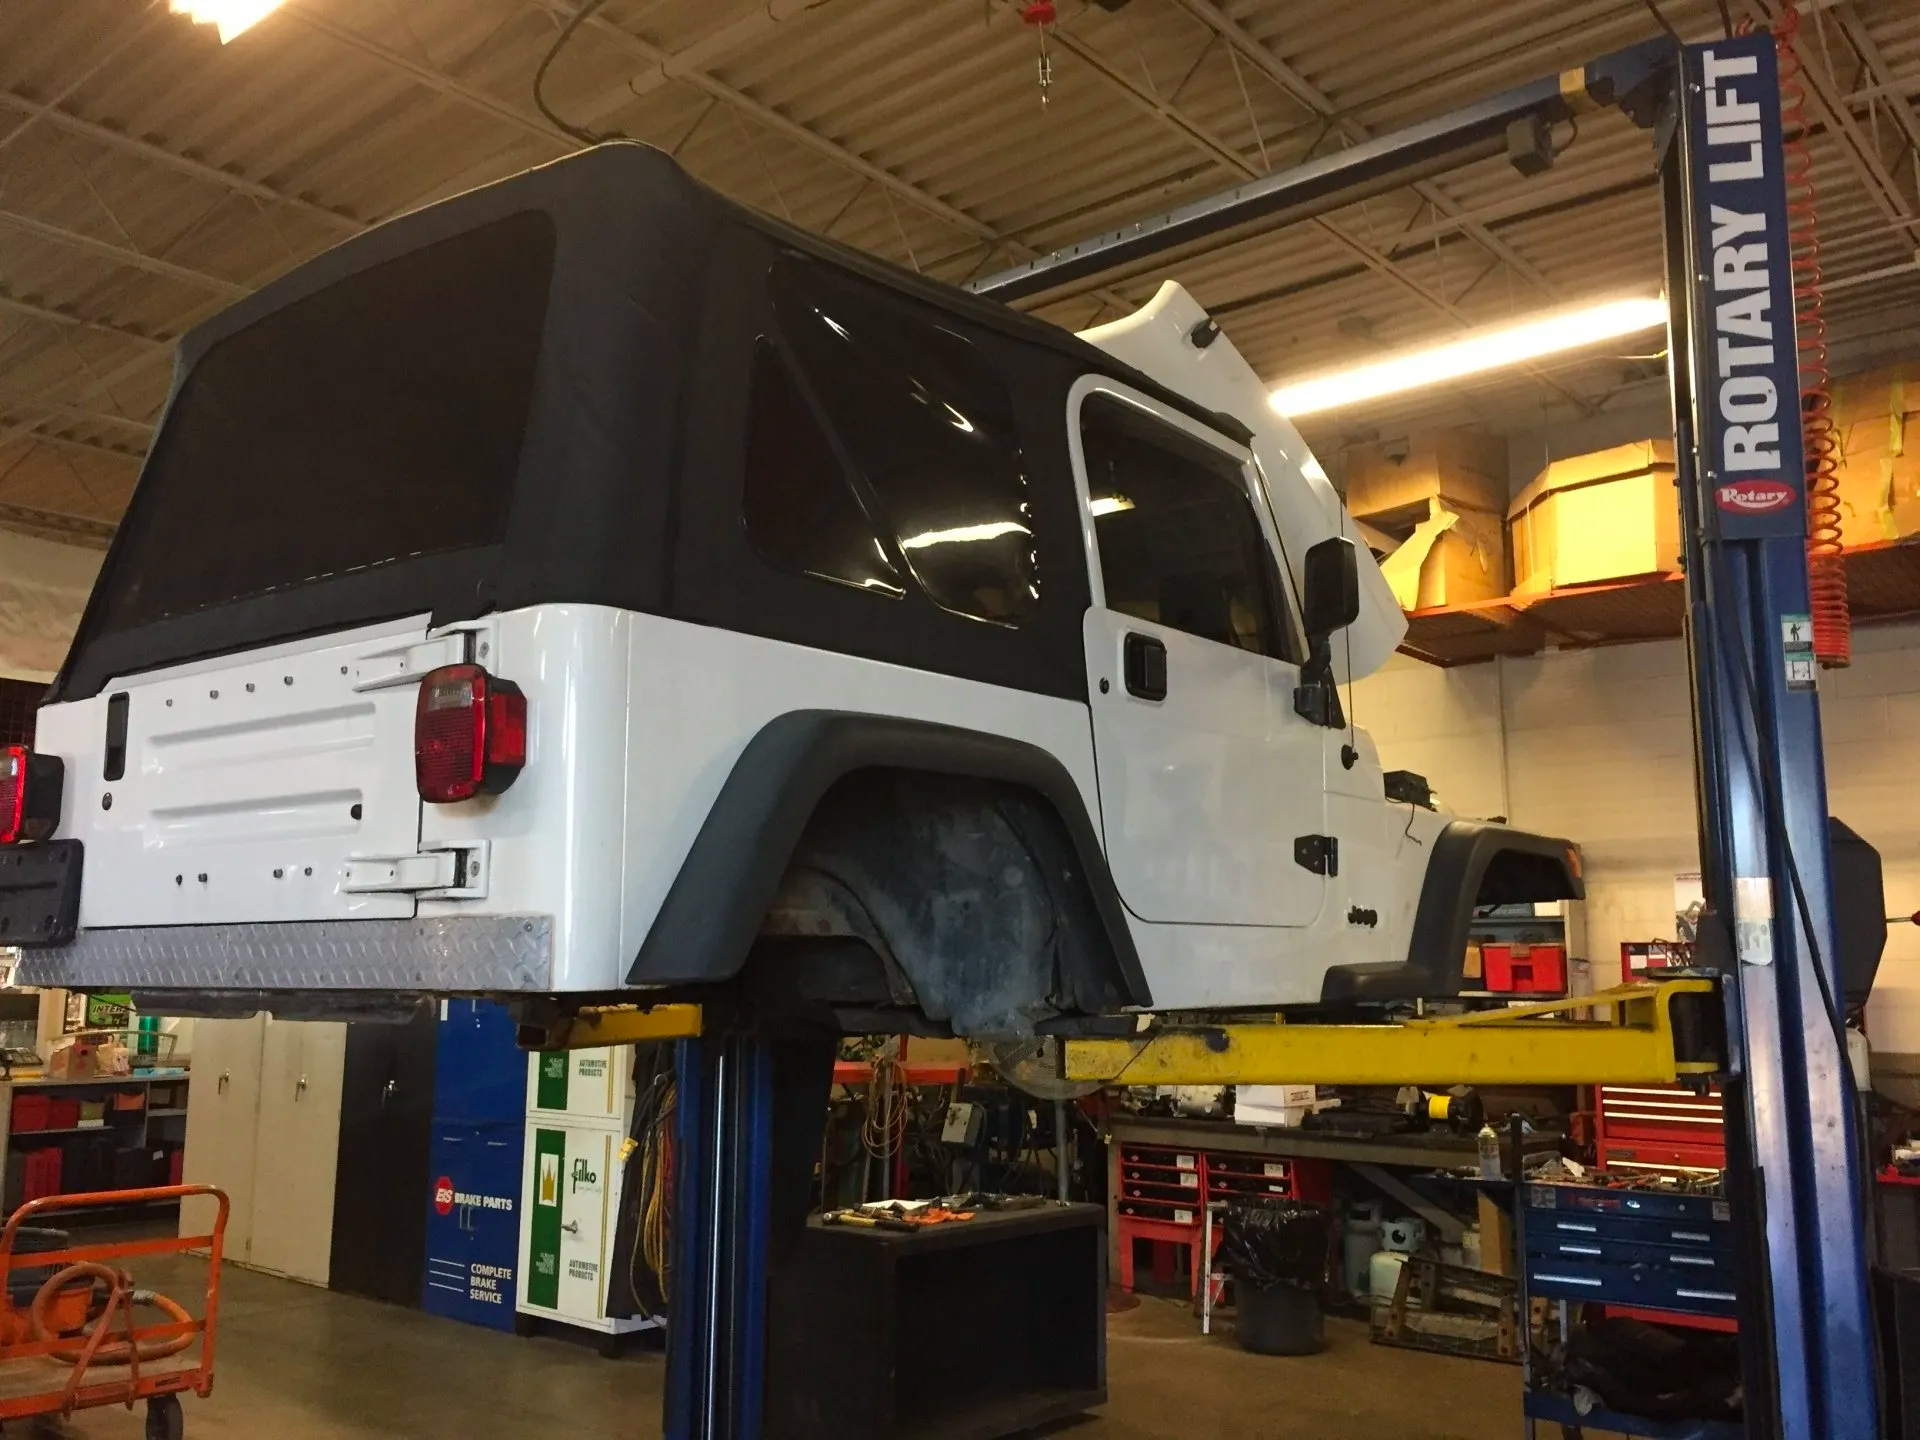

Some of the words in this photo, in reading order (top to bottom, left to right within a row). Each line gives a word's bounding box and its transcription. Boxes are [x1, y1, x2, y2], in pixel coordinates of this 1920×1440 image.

[1703, 50, 1764, 182] LIFT
[1711, 205, 1781, 472] ROTARY
[1720, 488, 1787, 508] Rotary
[1347, 904, 1378, 929] Jeep
[578, 1067, 603, 1078] PRODUCTS
[579, 1059, 607, 1069] AUTOMOTIVE
[571, 1158, 597, 1194] filko
[435, 1187, 453, 1204] EIS
[454, 1192, 482, 1206] BRAKE
[482, 1195, 513, 1211] PARTS
[470, 1263, 512, 1280] COMPLETE
[568, 1268, 594, 1281] PRODUCTS
[569, 1259, 599, 1273] AUTOMOTIVE
[470, 1275, 497, 1290] BRAKE
[469, 1289, 503, 1305] SERVICE
